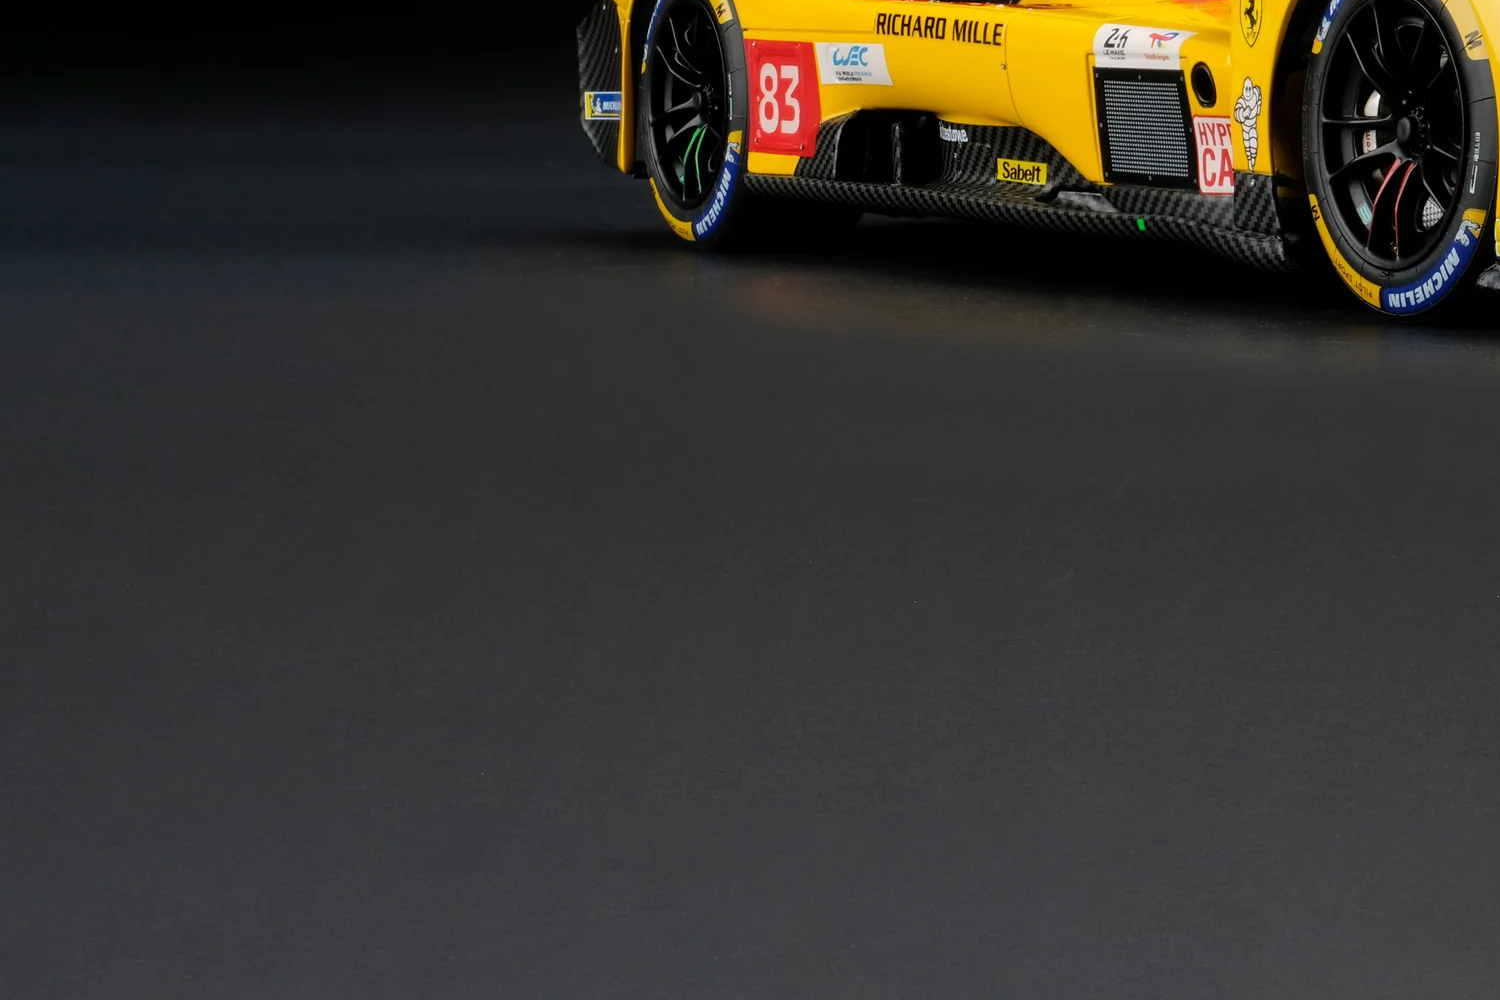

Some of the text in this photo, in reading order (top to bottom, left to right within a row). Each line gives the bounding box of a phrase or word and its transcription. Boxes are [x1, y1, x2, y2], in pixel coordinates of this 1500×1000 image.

[876, 12, 1004, 46] RICHARD MILLE
[833, 46, 868, 66] WEC
[759, 63, 800, 134] 83
[1002, 161, 1041, 182] Sabelt
[695, 167, 732, 235] MICHELIN
[1388, 247, 1461, 308] MICHELIN
